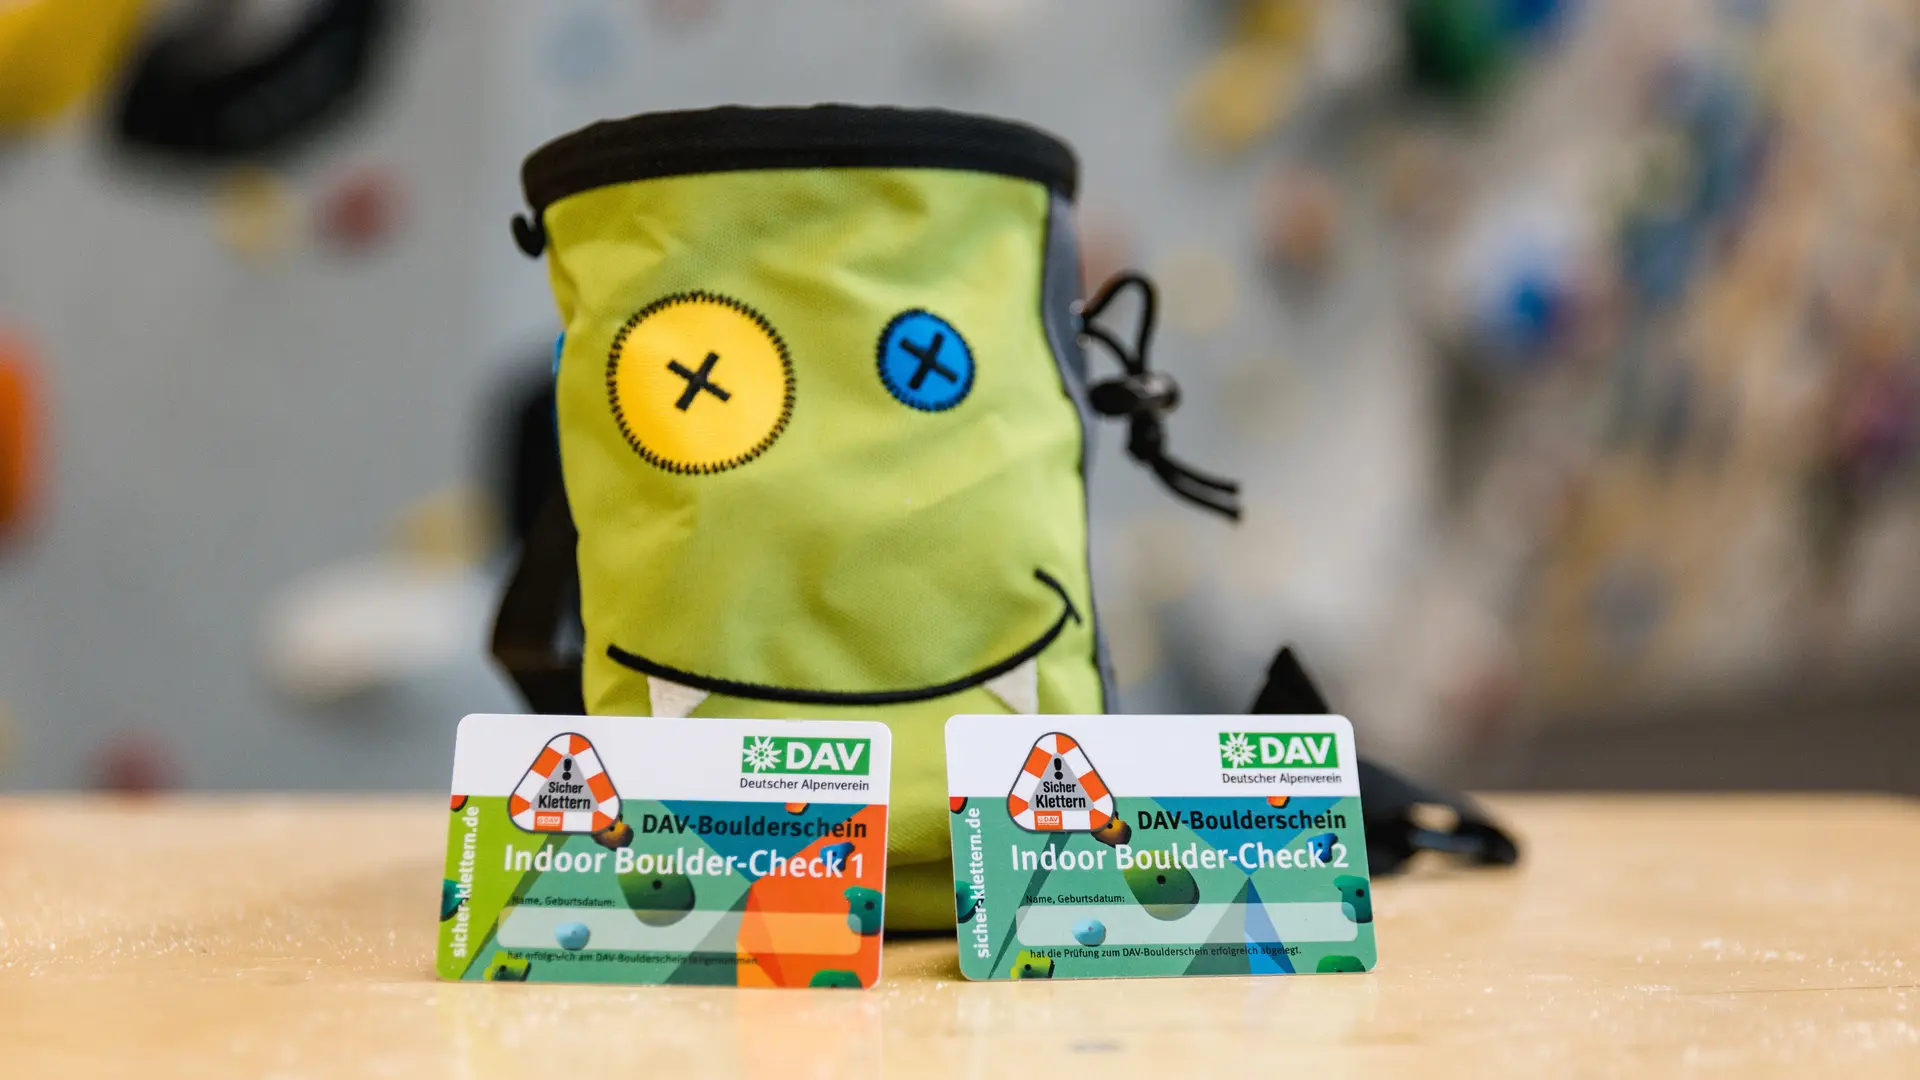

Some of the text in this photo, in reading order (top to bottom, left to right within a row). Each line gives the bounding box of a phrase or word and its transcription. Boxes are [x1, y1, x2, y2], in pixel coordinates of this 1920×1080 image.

[786, 741, 866, 771] DAV
[1260, 736, 1331, 765] DAV
[740, 777, 870, 792] Deutscher Alpenverein
[1222, 772, 1342, 786] Deutscher Alpenverein
[548, 781, 583, 794] Sicher
[1043, 781, 1076, 793] Sicher
[538, 795, 591, 810] Klettern
[1036, 794, 1086, 809] Klettern
[642, 814, 867, 838] DAV-Boulderschein
[1137, 810, 1346, 830] DAV-Boulderschein
[504, 844, 863, 878] Indoor Boulder-Check 1
[1011, 841, 1349, 871] Indoor Boulder-Check 2
[450, 806, 479, 958] sicher-klettern.de
[965, 808, 990, 958] sicher-klettern.de
[511, 896, 616, 907] Name, Geburtsdatum:
[1026, 894, 1125, 904] Name, Geburtsdatum:
[578, 953, 593, 961] am
[1030, 945, 1302, 959] hat die Prüfung zum DAV-Boulderschein erfolgreich abgelegt.
